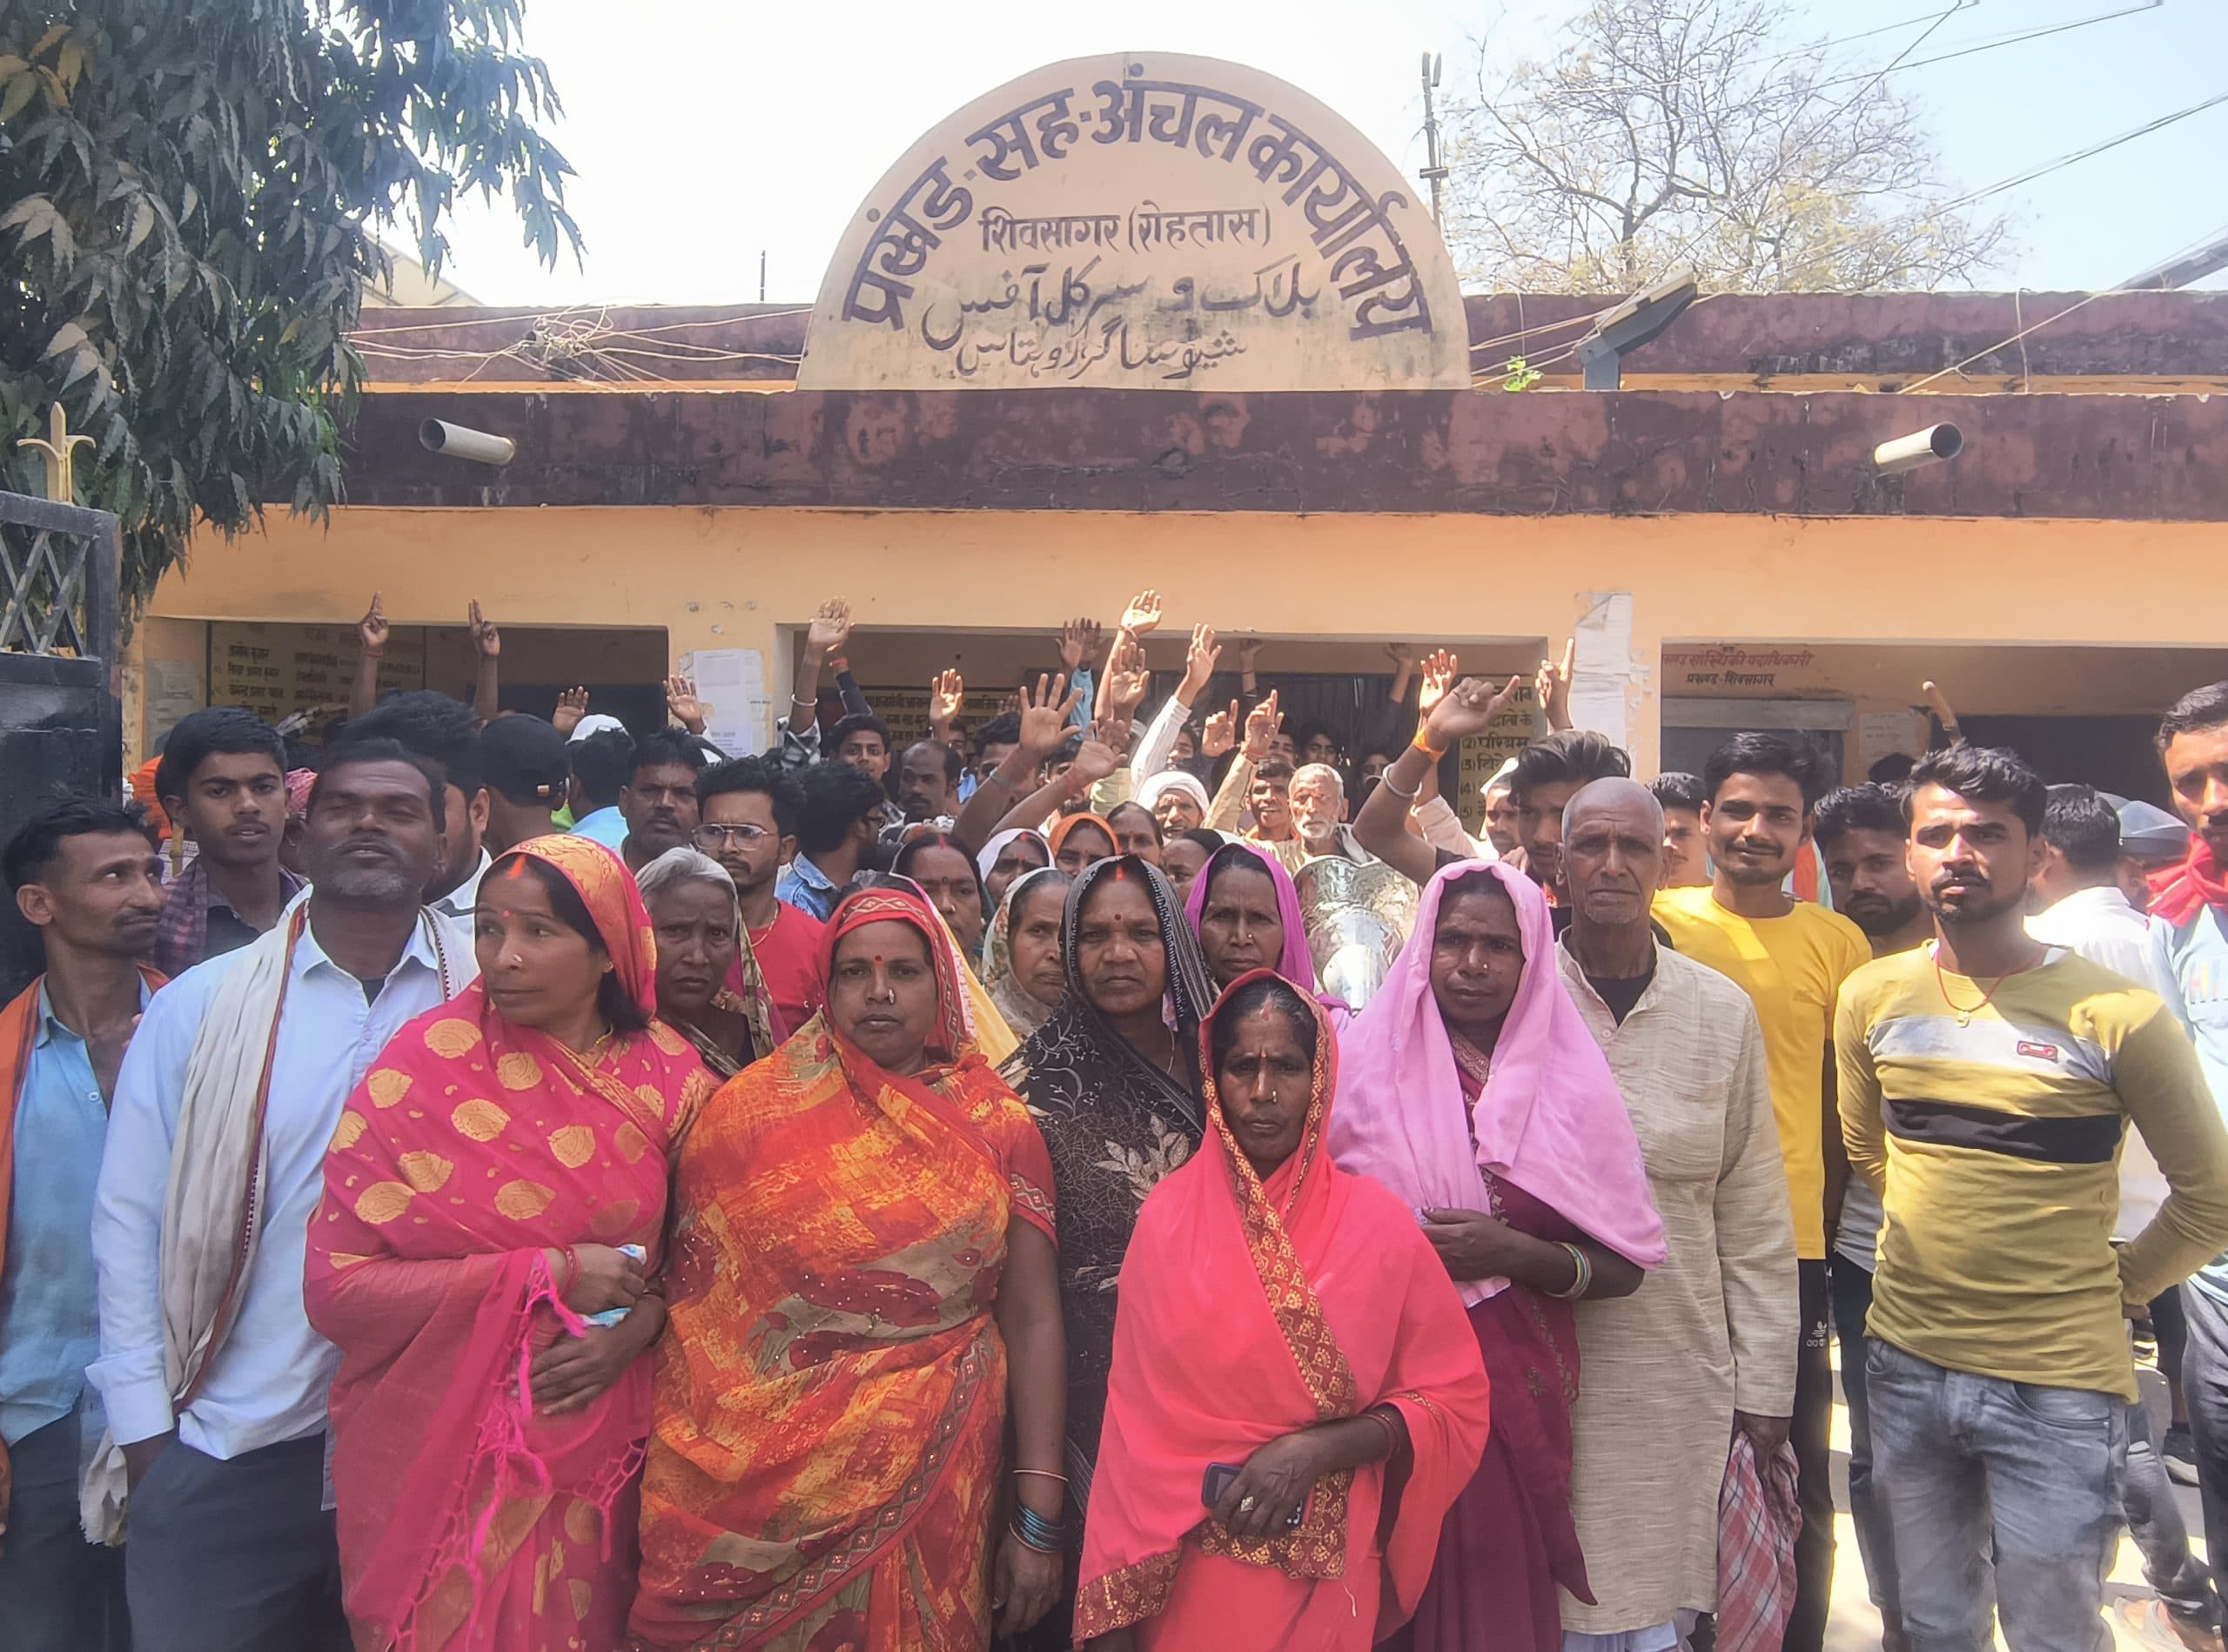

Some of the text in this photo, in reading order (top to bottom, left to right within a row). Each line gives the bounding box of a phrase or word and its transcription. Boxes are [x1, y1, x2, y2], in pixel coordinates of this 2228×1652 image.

[978, 199, 1271, 255] शिवसागर (रोहतास)
[1248, 113, 1433, 342] कार्यालय
